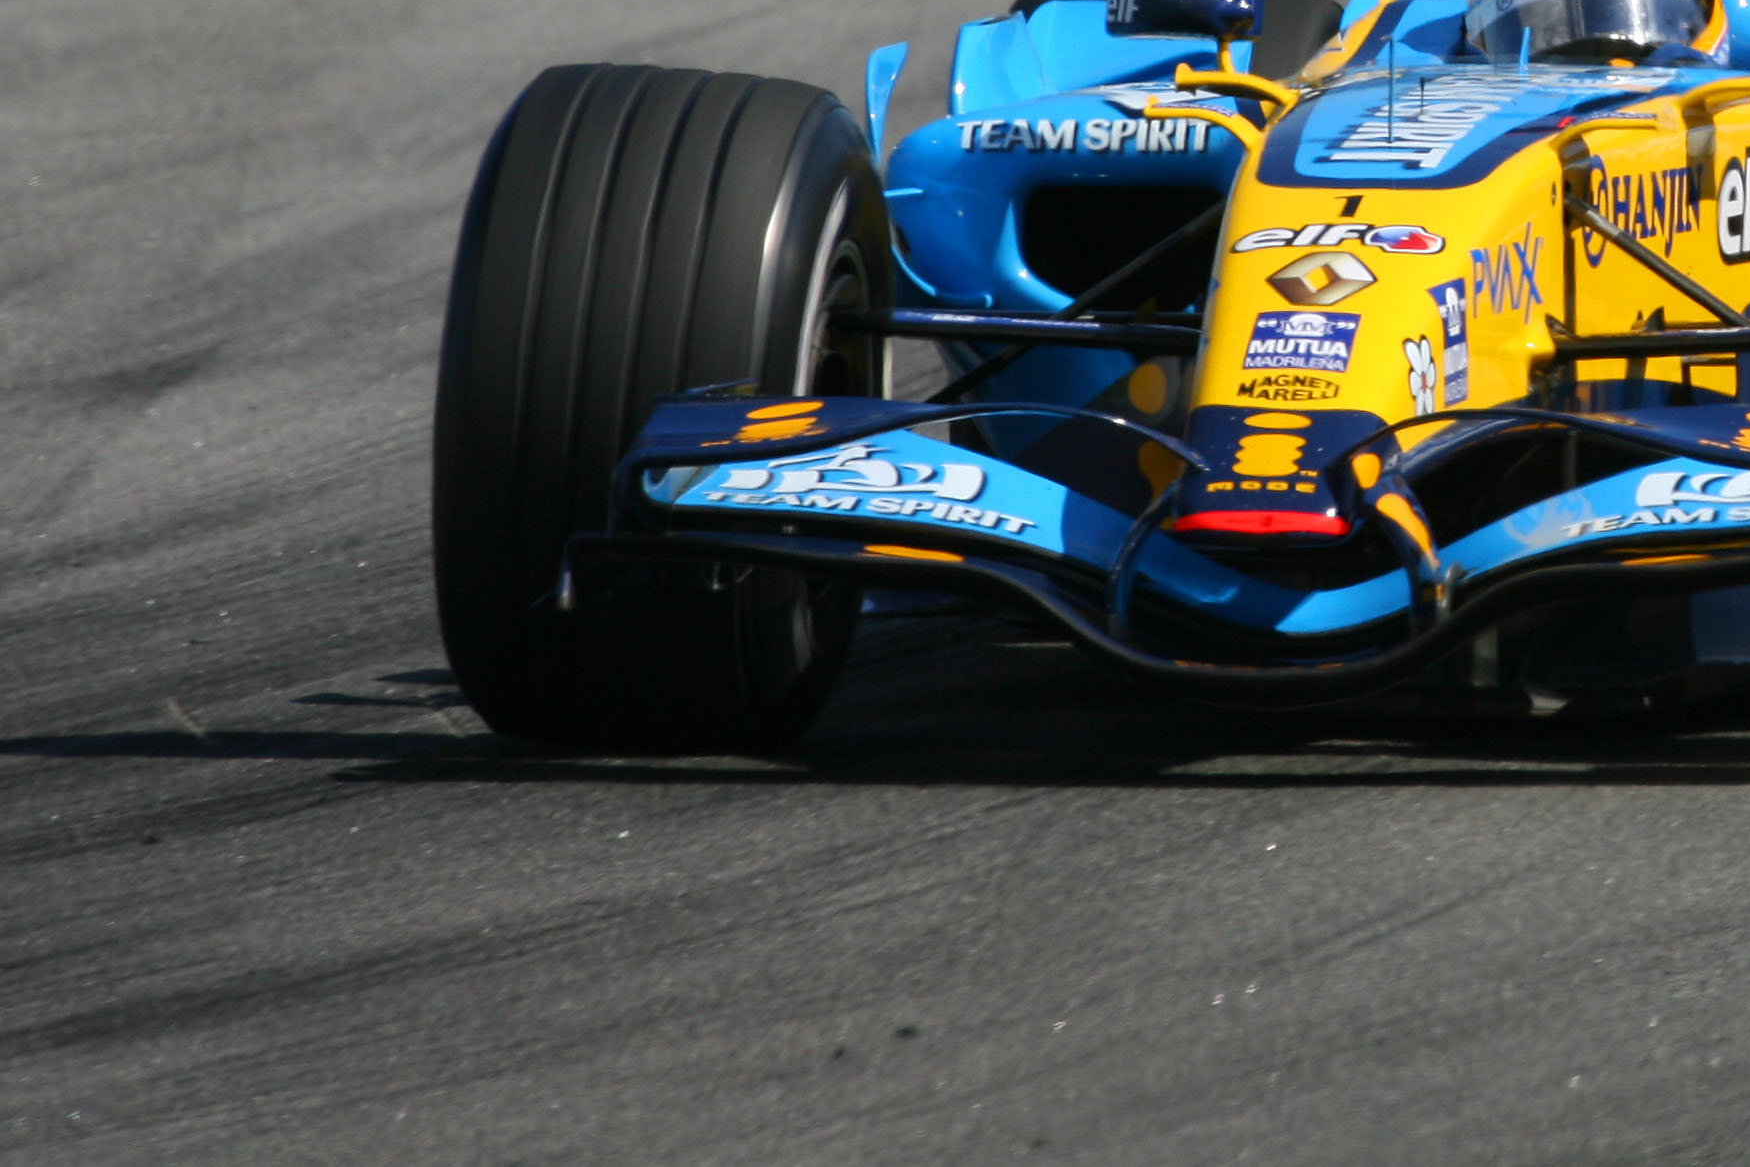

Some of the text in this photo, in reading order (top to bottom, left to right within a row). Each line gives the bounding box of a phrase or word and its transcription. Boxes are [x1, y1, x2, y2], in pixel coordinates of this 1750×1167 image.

[957, 117, 1214, 153] TEAM SPIRIT
[1328, 100, 1502, 169] SPIRIT
[1334, 194, 1365, 218] 1
[1611, 162, 1704, 259] HANJIN
[1230, 223, 1374, 254] elf
[1247, 338, 1349, 358] MUTUA
[701, 490, 1040, 536] TEAM SPIRIT
[1560, 506, 1717, 537] TEAM
